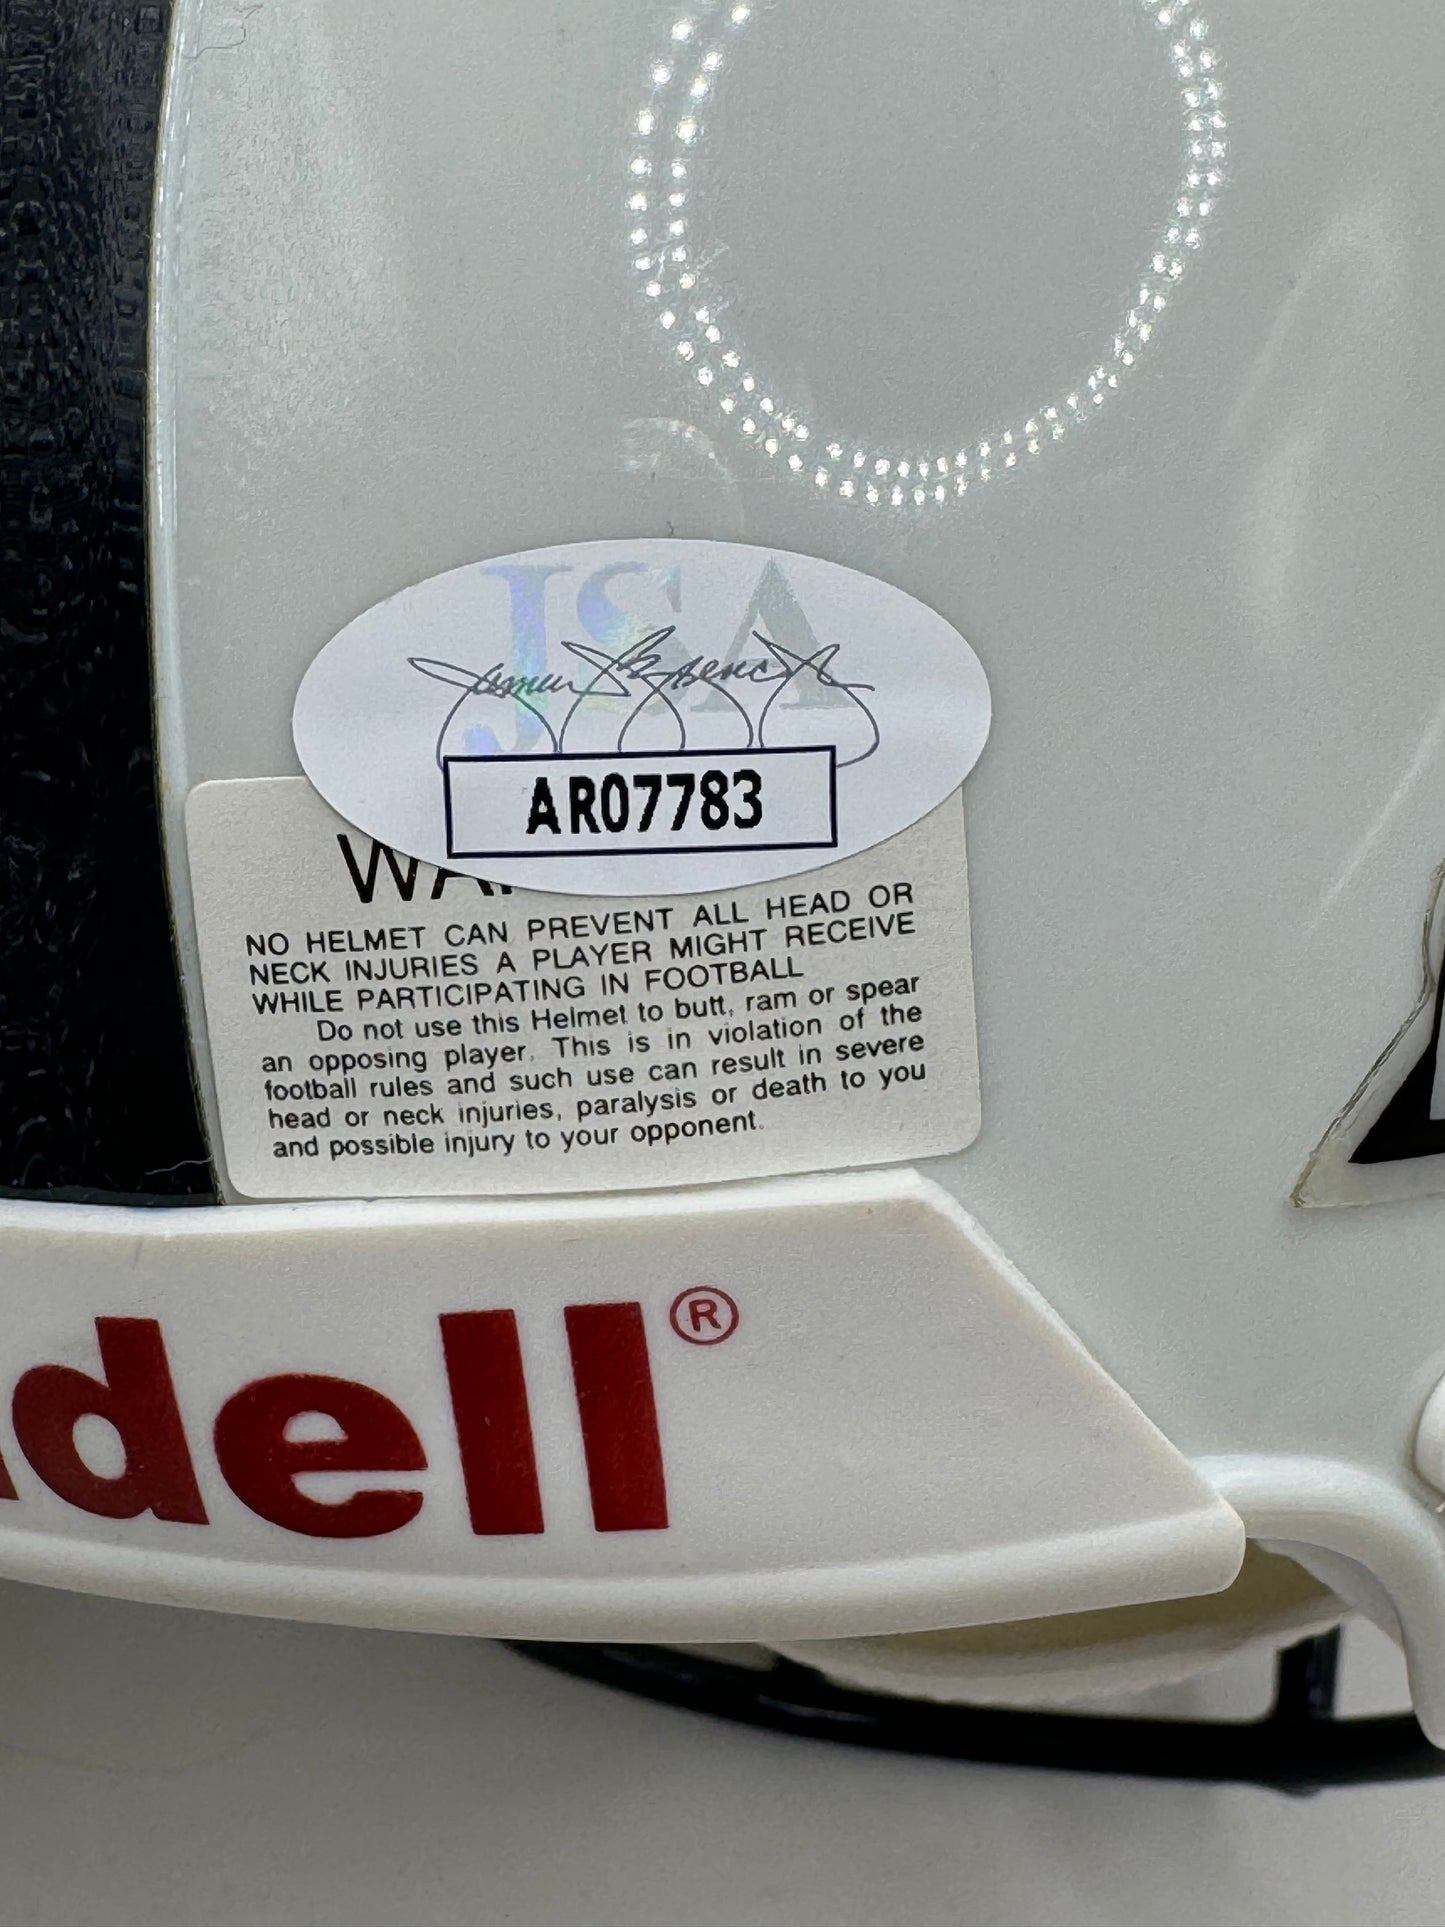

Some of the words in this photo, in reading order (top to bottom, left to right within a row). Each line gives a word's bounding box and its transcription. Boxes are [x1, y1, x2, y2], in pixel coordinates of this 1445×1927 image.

[462, 556, 858, 752] JSA
[525, 768, 763, 835] AR07783
[245, 931, 290, 957] NO
[305, 925, 427, 955] HELMET
[443, 920, 509, 948] CAN
[526, 908, 675, 943] PREVENT
[692, 900, 750, 929] ALL
[765, 889, 851, 921] HEAD
[867, 881, 914, 909] OR
[248, 960, 332, 987] NECK
[345, 952, 480, 982] INJURIES
[495, 950, 517, 975] A
[531, 940, 653, 972] PLAYER
[669, 927, 769, 960] MIGHT
[784, 910, 917, 949] RECEIVE
[251, 989, 345, 1016] WHILE
[356, 975, 586, 1012] PARTICIPATING
[600, 971, 630, 997] IN
[644, 955, 805, 993] FOOTBALL
[316, 1019, 354, 1042] Do
[363, 1018, 405, 1041] not
[414, 1018, 463, 1039] use
[470, 1010, 520, 1036] this
[530, 1003, 629, 1032] Helmet
[636, 1001, 664, 1024] to
[745, 990, 798, 1013] ram
[807, 986, 836, 1007] or
[845, 975, 921, 1006] spear
[261, 1055, 293, 1074] an
[307, 1045, 428, 1077] opposing
[550, 1035, 612, 1059] This
[627, 1030, 651, 1054] is
[667, 1026, 692, 1050] in
[707, 1016, 822, 1047] violation
[838, 1006, 865, 1032] of
[879, 1002, 923, 1027] the
[263, 1076, 357, 1102] football
[369, 1075, 434, 1099] rules
[447, 1070, 497, 1096] and
[508, 1066, 573, 1093] such
[586, 1066, 636, 1087] use
[647, 1061, 698, 1083] can
[711, 1046, 787, 1076] result
[798, 1043, 822, 1066] in
[835, 1034, 925, 1062] severe
[267, 1105, 332, 1130] head
[344, 1110, 370, 1128] or
[382, 1102, 446, 1127] neck
[457, 1098, 562, 1129] injuries,
[576, 1086, 698, 1124] paralysis
[711, 1086, 739, 1107] or
[751, 1071, 827, 1101] death
[840, 1069, 866, 1091] to
[877, 1063, 926, 1091] you
[272, 1134, 320, 1159] and
[329, 1132, 435, 1162] possible
[443, 1129, 516, 1159] injury
[524, 1128, 551, 1151] to
[560, 1124, 619, 1154] your
[0, 1301, 669, 1539] dell
